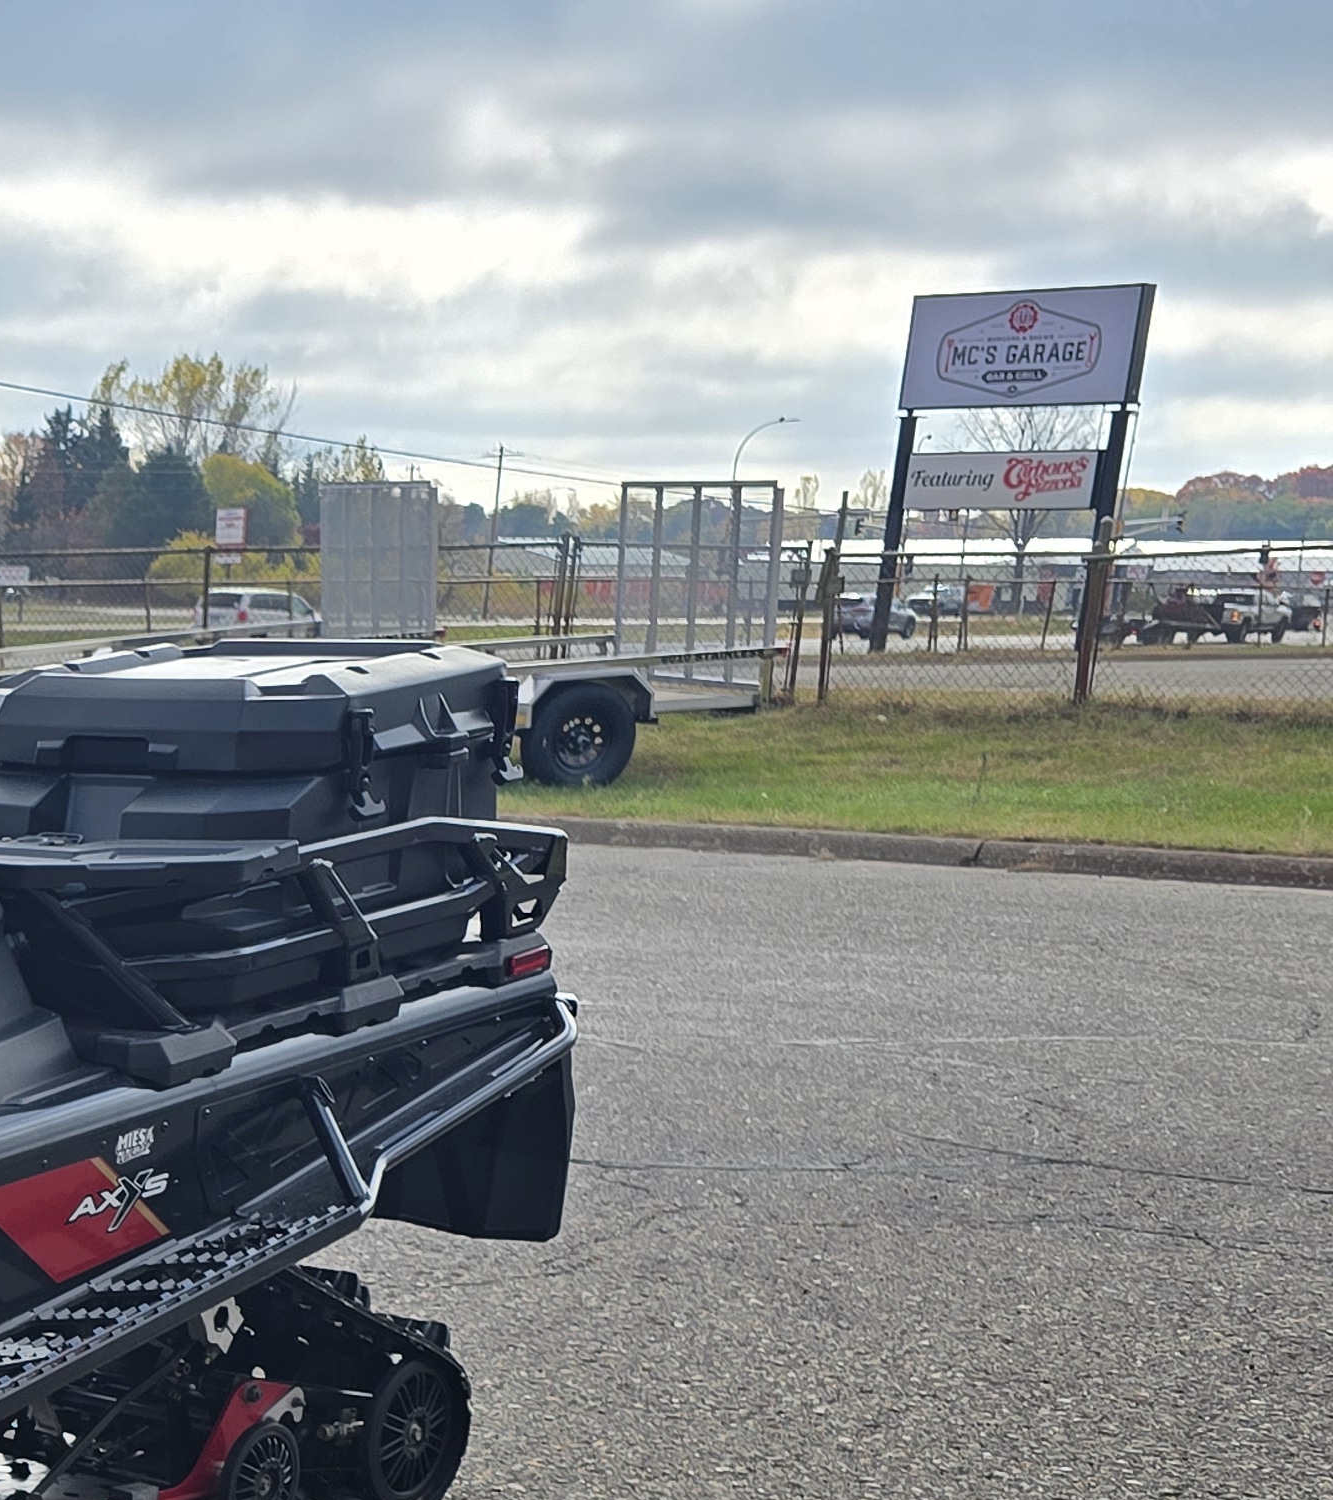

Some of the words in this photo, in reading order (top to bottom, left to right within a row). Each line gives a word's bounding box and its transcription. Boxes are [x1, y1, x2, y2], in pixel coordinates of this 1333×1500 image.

[951, 345, 998, 366] MC'S
[1005, 341, 1088, 365] GARAGE
[911, 469, 995, 492] Featuring
